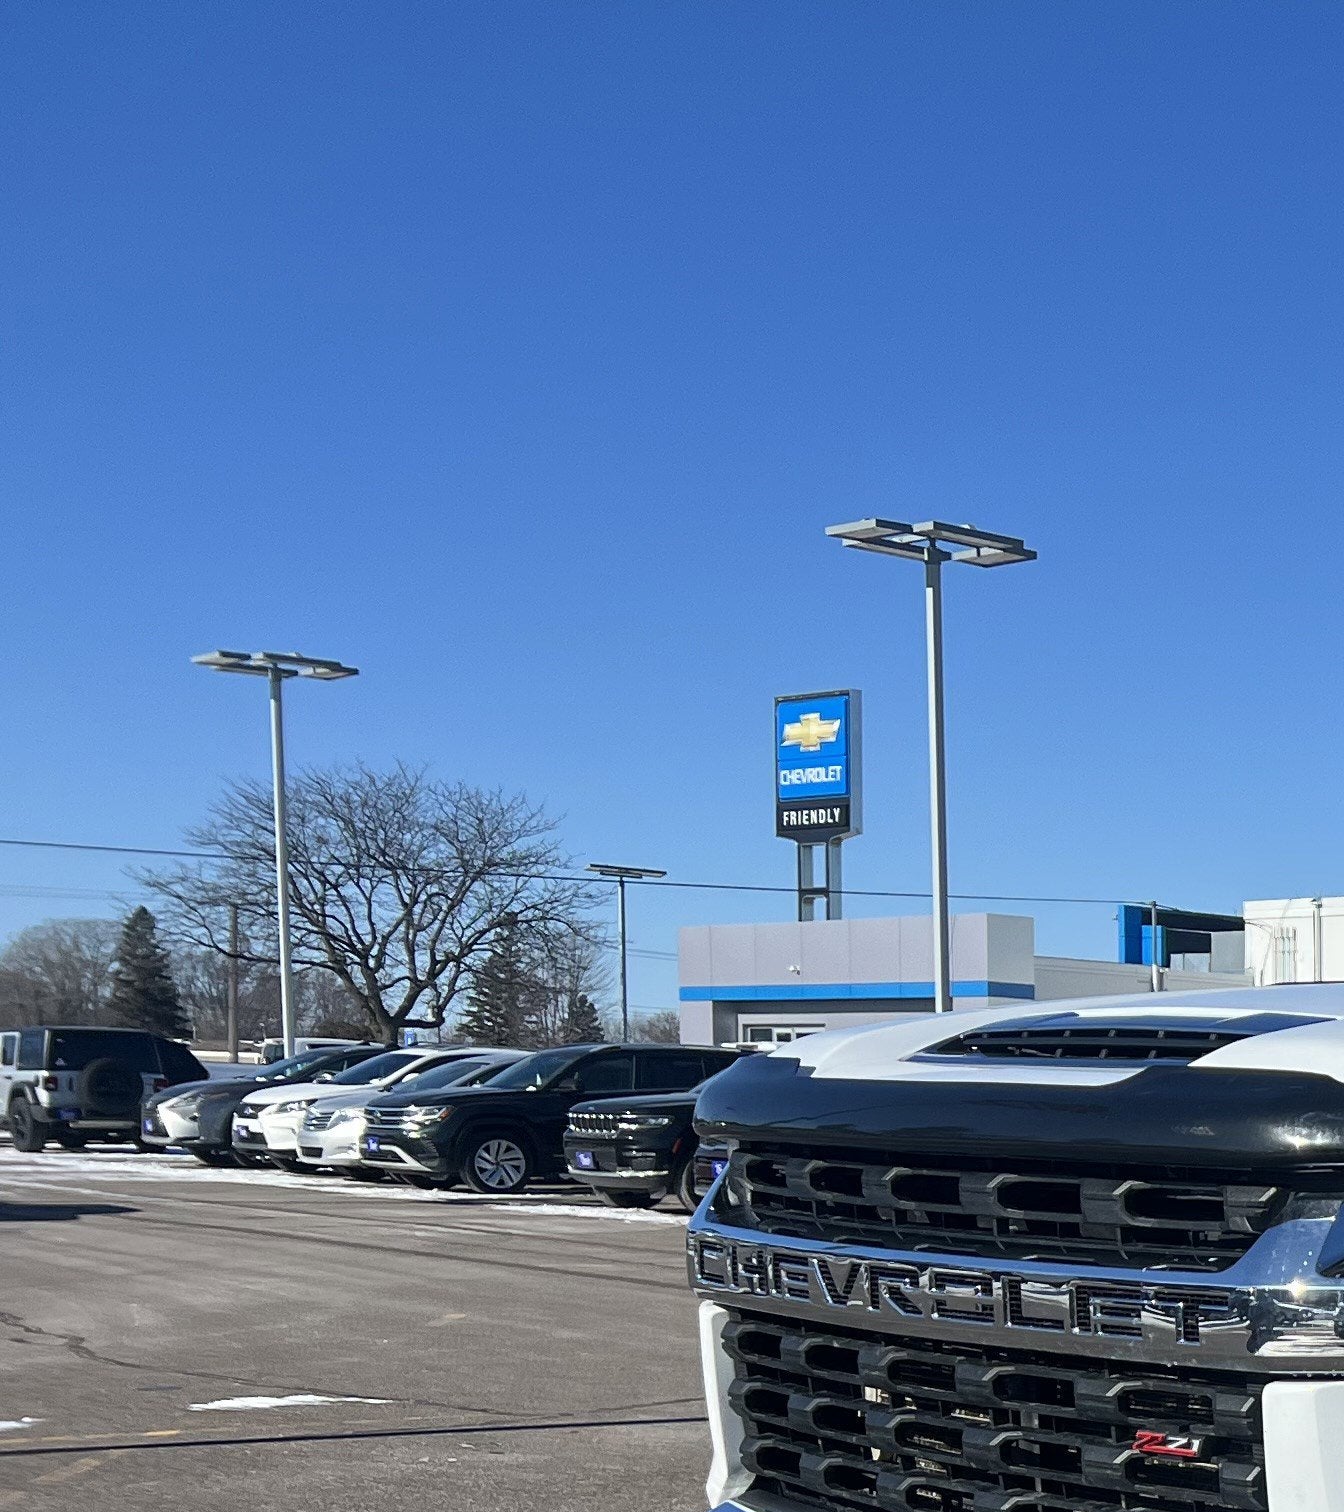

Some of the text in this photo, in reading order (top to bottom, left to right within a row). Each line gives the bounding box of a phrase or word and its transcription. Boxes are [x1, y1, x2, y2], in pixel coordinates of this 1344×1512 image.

[779, 766, 842, 786] CHEVROLET
[782, 808, 841, 826] FRIENDLY
[694, 1235, 1231, 1346] CHEVROLET
